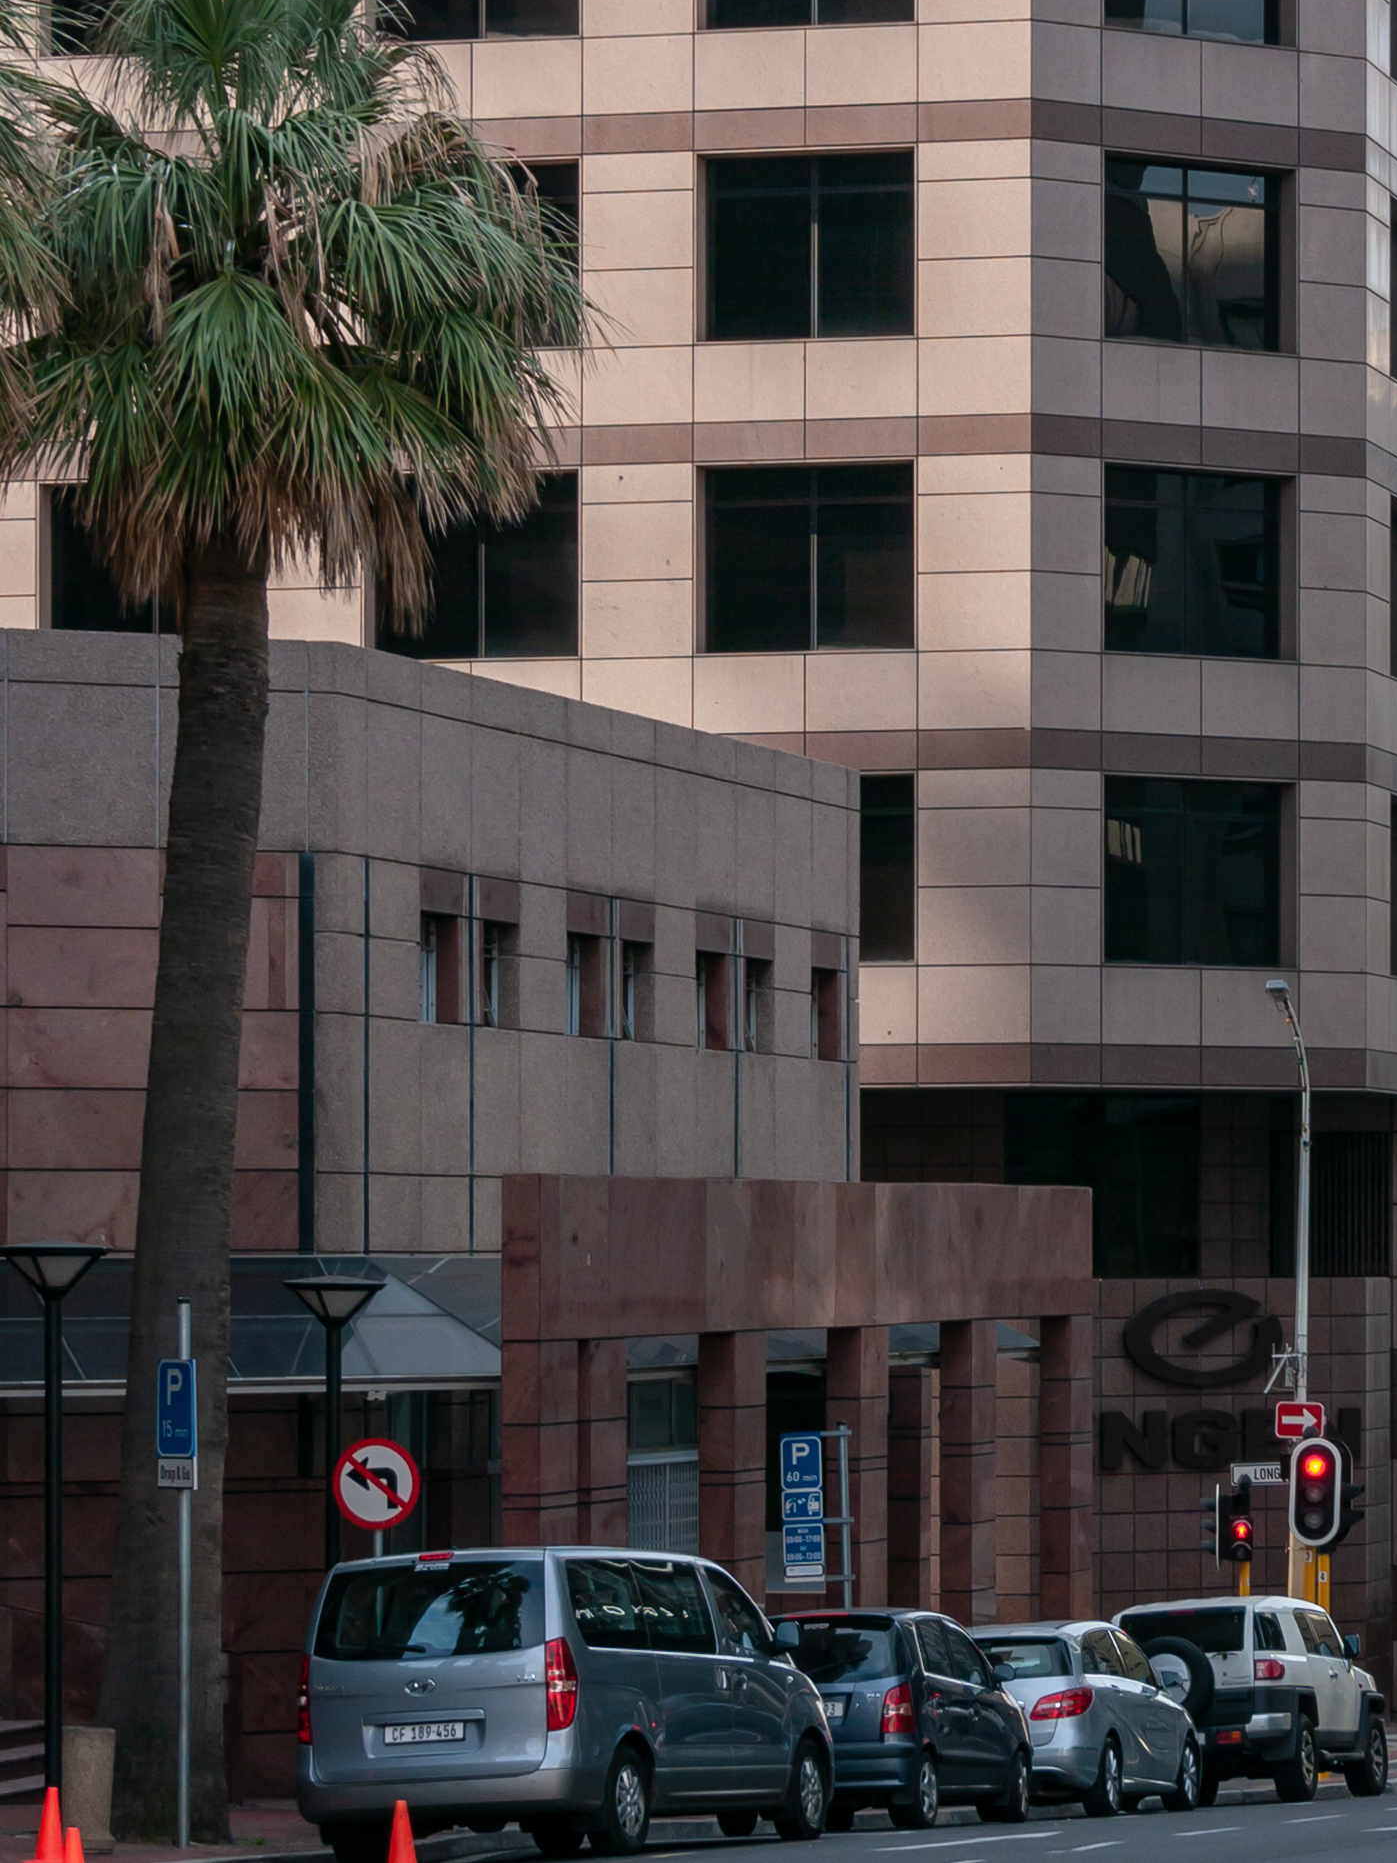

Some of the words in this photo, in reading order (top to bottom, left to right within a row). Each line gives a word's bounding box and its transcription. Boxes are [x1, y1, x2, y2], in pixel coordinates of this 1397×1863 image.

[167, 1368, 183, 1406] P
[162, 1419, 173, 1438] 15
[791, 1442, 810, 1466] P
[786, 1471, 800, 1482] 60
[1253, 1467, 1280, 1481] LONG
[392, 1727, 406, 1742] CF
